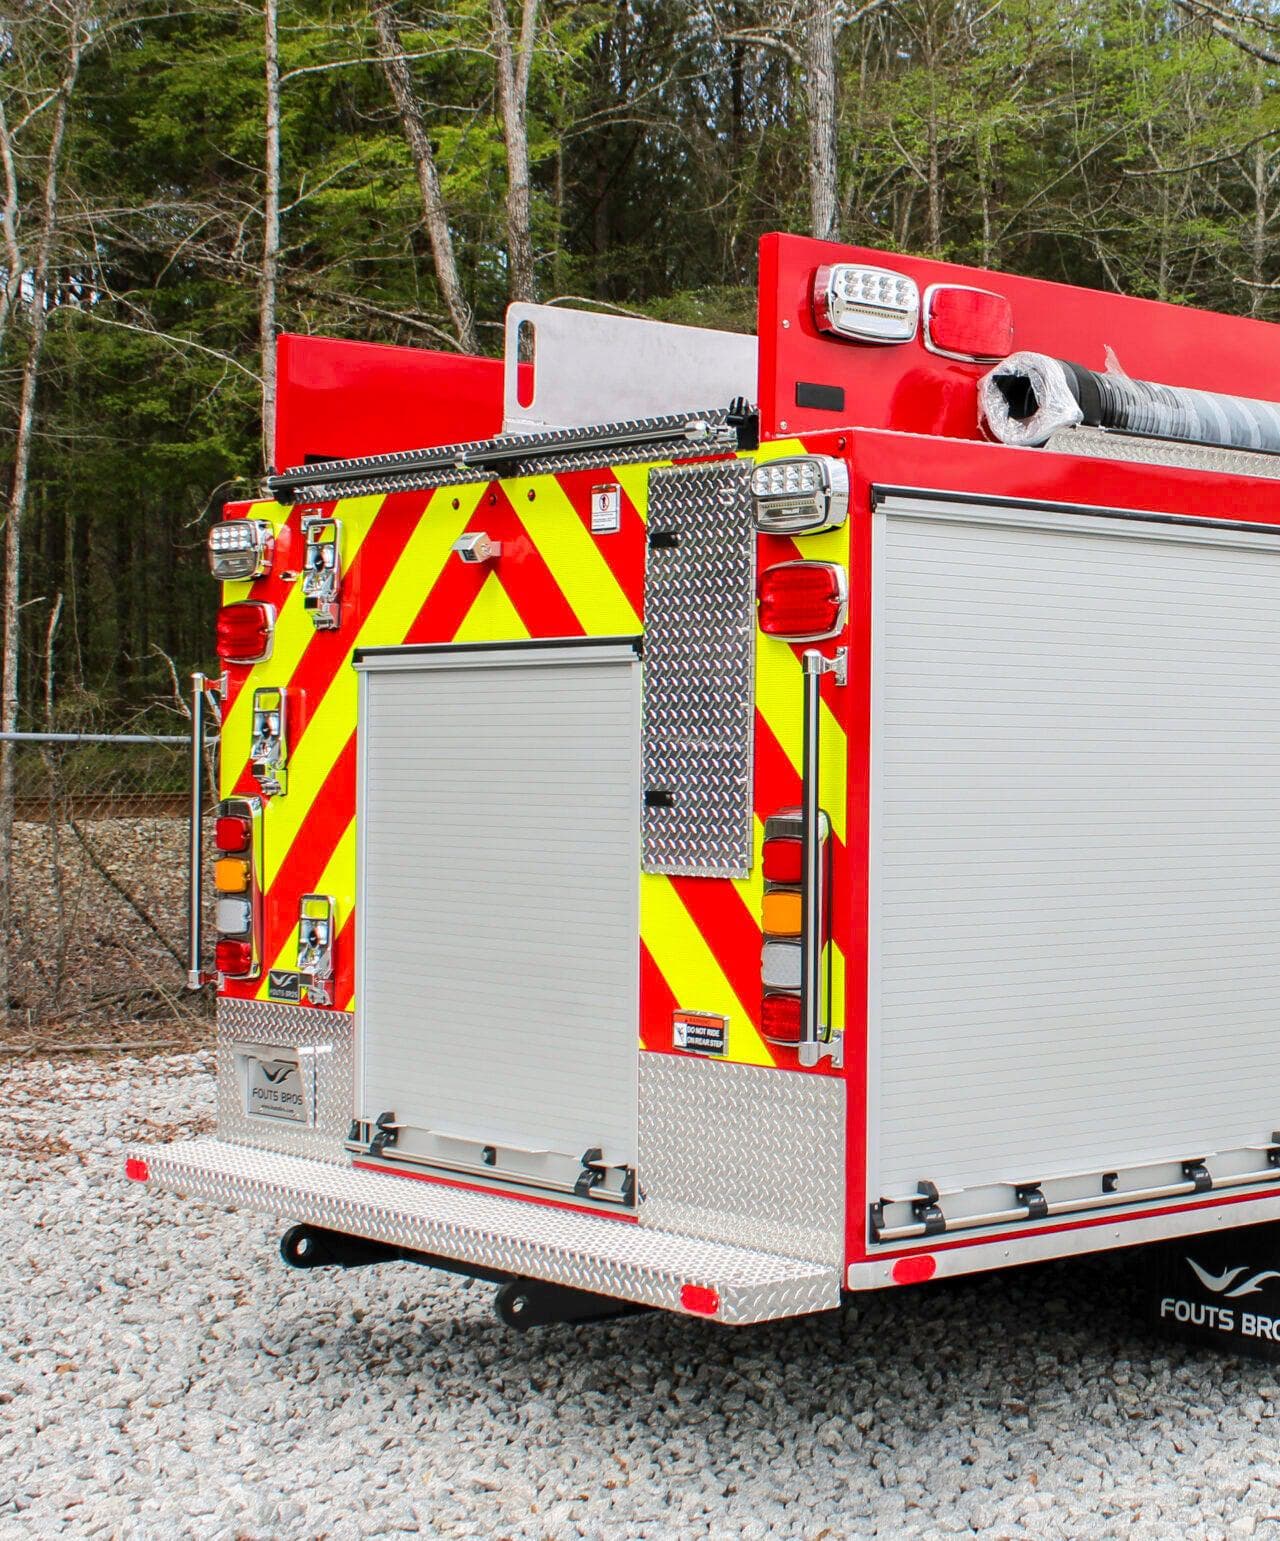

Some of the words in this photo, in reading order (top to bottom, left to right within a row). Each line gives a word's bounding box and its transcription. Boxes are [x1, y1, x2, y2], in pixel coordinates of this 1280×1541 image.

[252, 1088, 278, 1101] FOUTS
[281, 1092, 303, 1105] BROS
[1160, 1298, 1234, 1331] FOUTS
